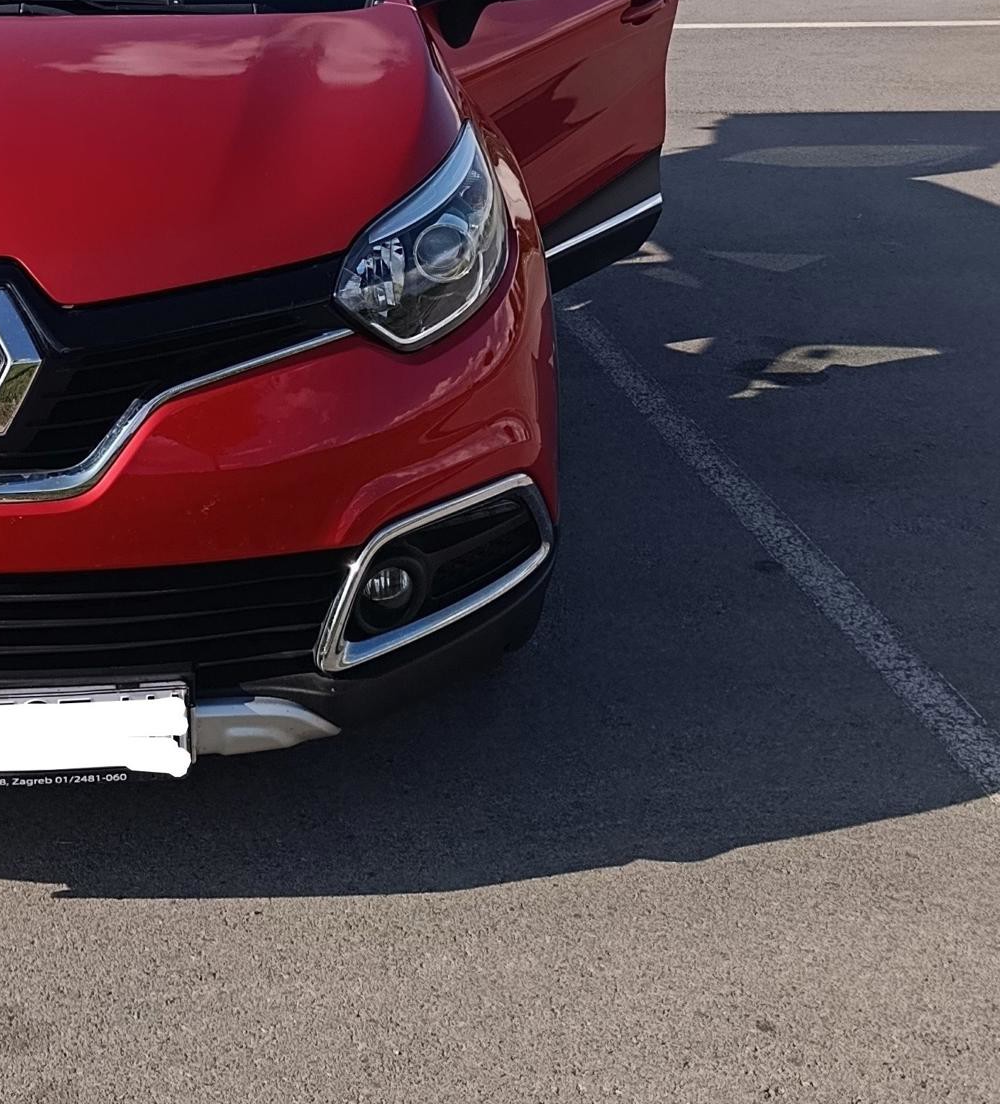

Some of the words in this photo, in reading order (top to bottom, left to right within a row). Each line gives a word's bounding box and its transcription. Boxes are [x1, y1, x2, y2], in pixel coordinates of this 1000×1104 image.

[0, 778, 9, 787] 8,
[11, 776, 53, 787] Zagreb
[55, 772, 128, 784] 01/2481-060
